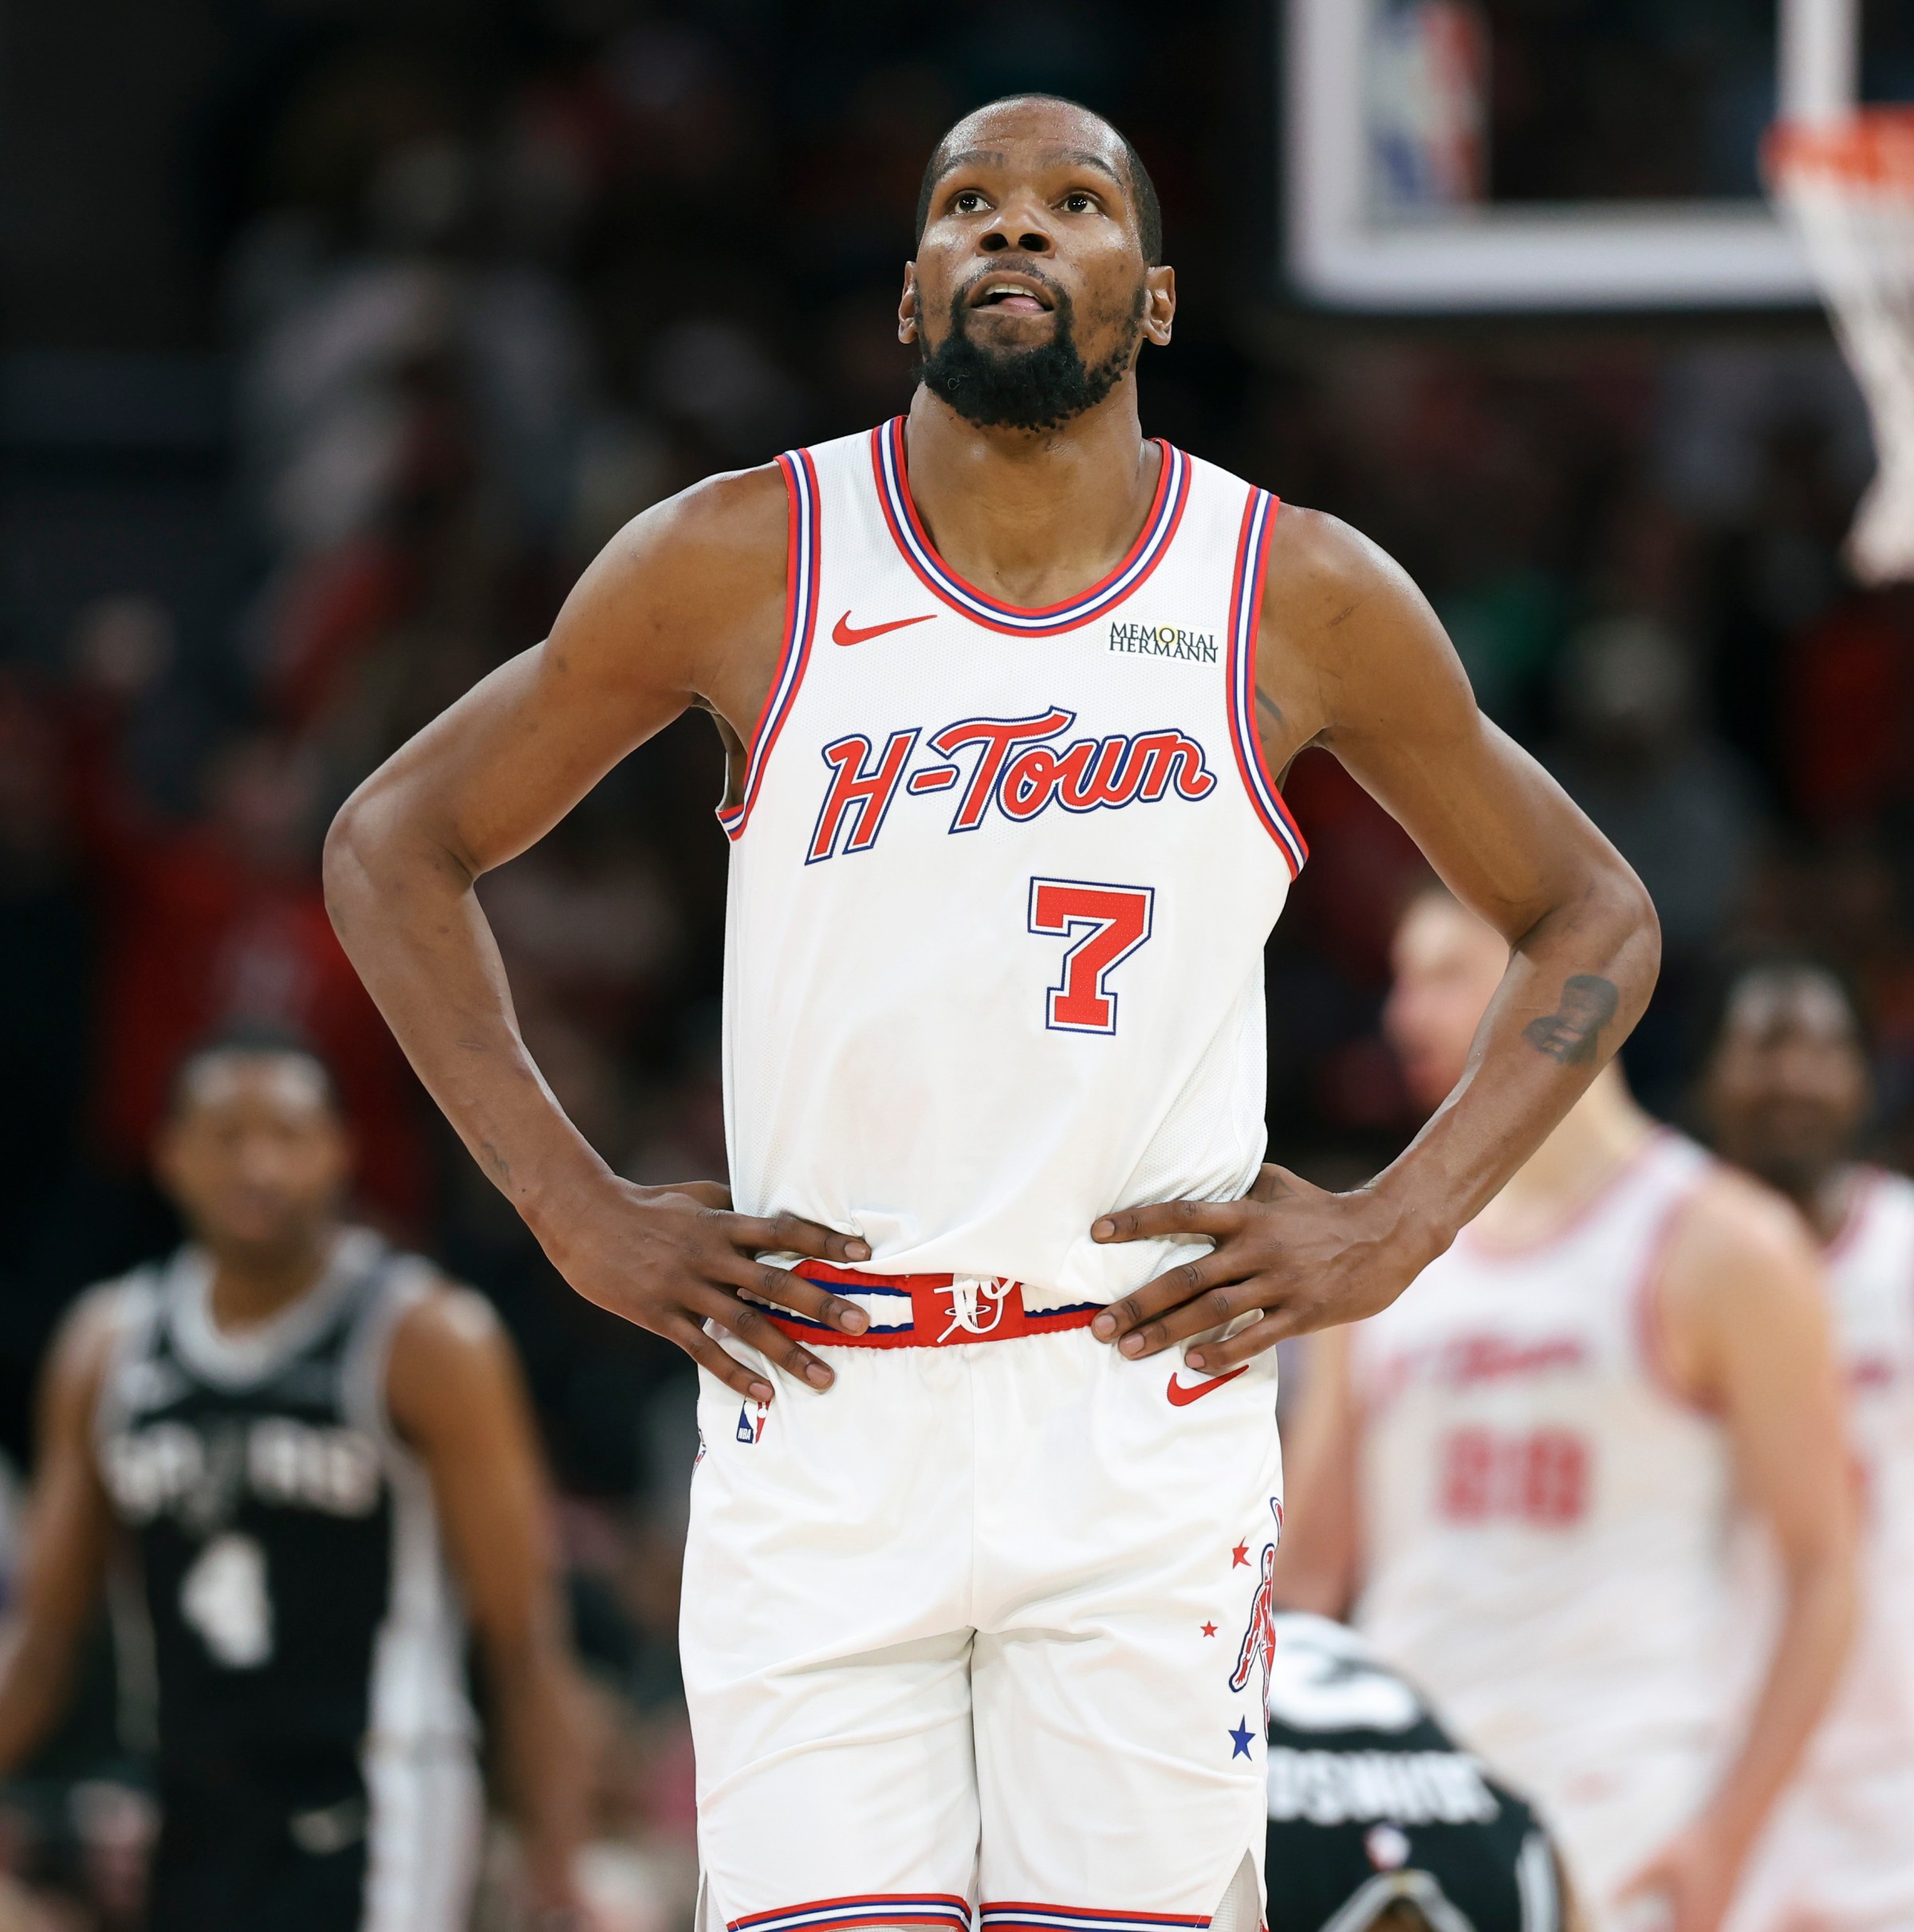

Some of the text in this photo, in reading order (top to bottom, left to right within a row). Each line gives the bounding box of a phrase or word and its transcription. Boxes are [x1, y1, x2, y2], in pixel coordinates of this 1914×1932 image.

[1109, 621, 1219, 650] MEMORIAL
[1109, 635, 1218, 663] HERMANN
[805, 706, 1218, 866] H-Town
[1027, 876, 1156, 1037] 7
[737, 1427, 752, 1441] NBA
[183, 1535, 272, 1668] 4
